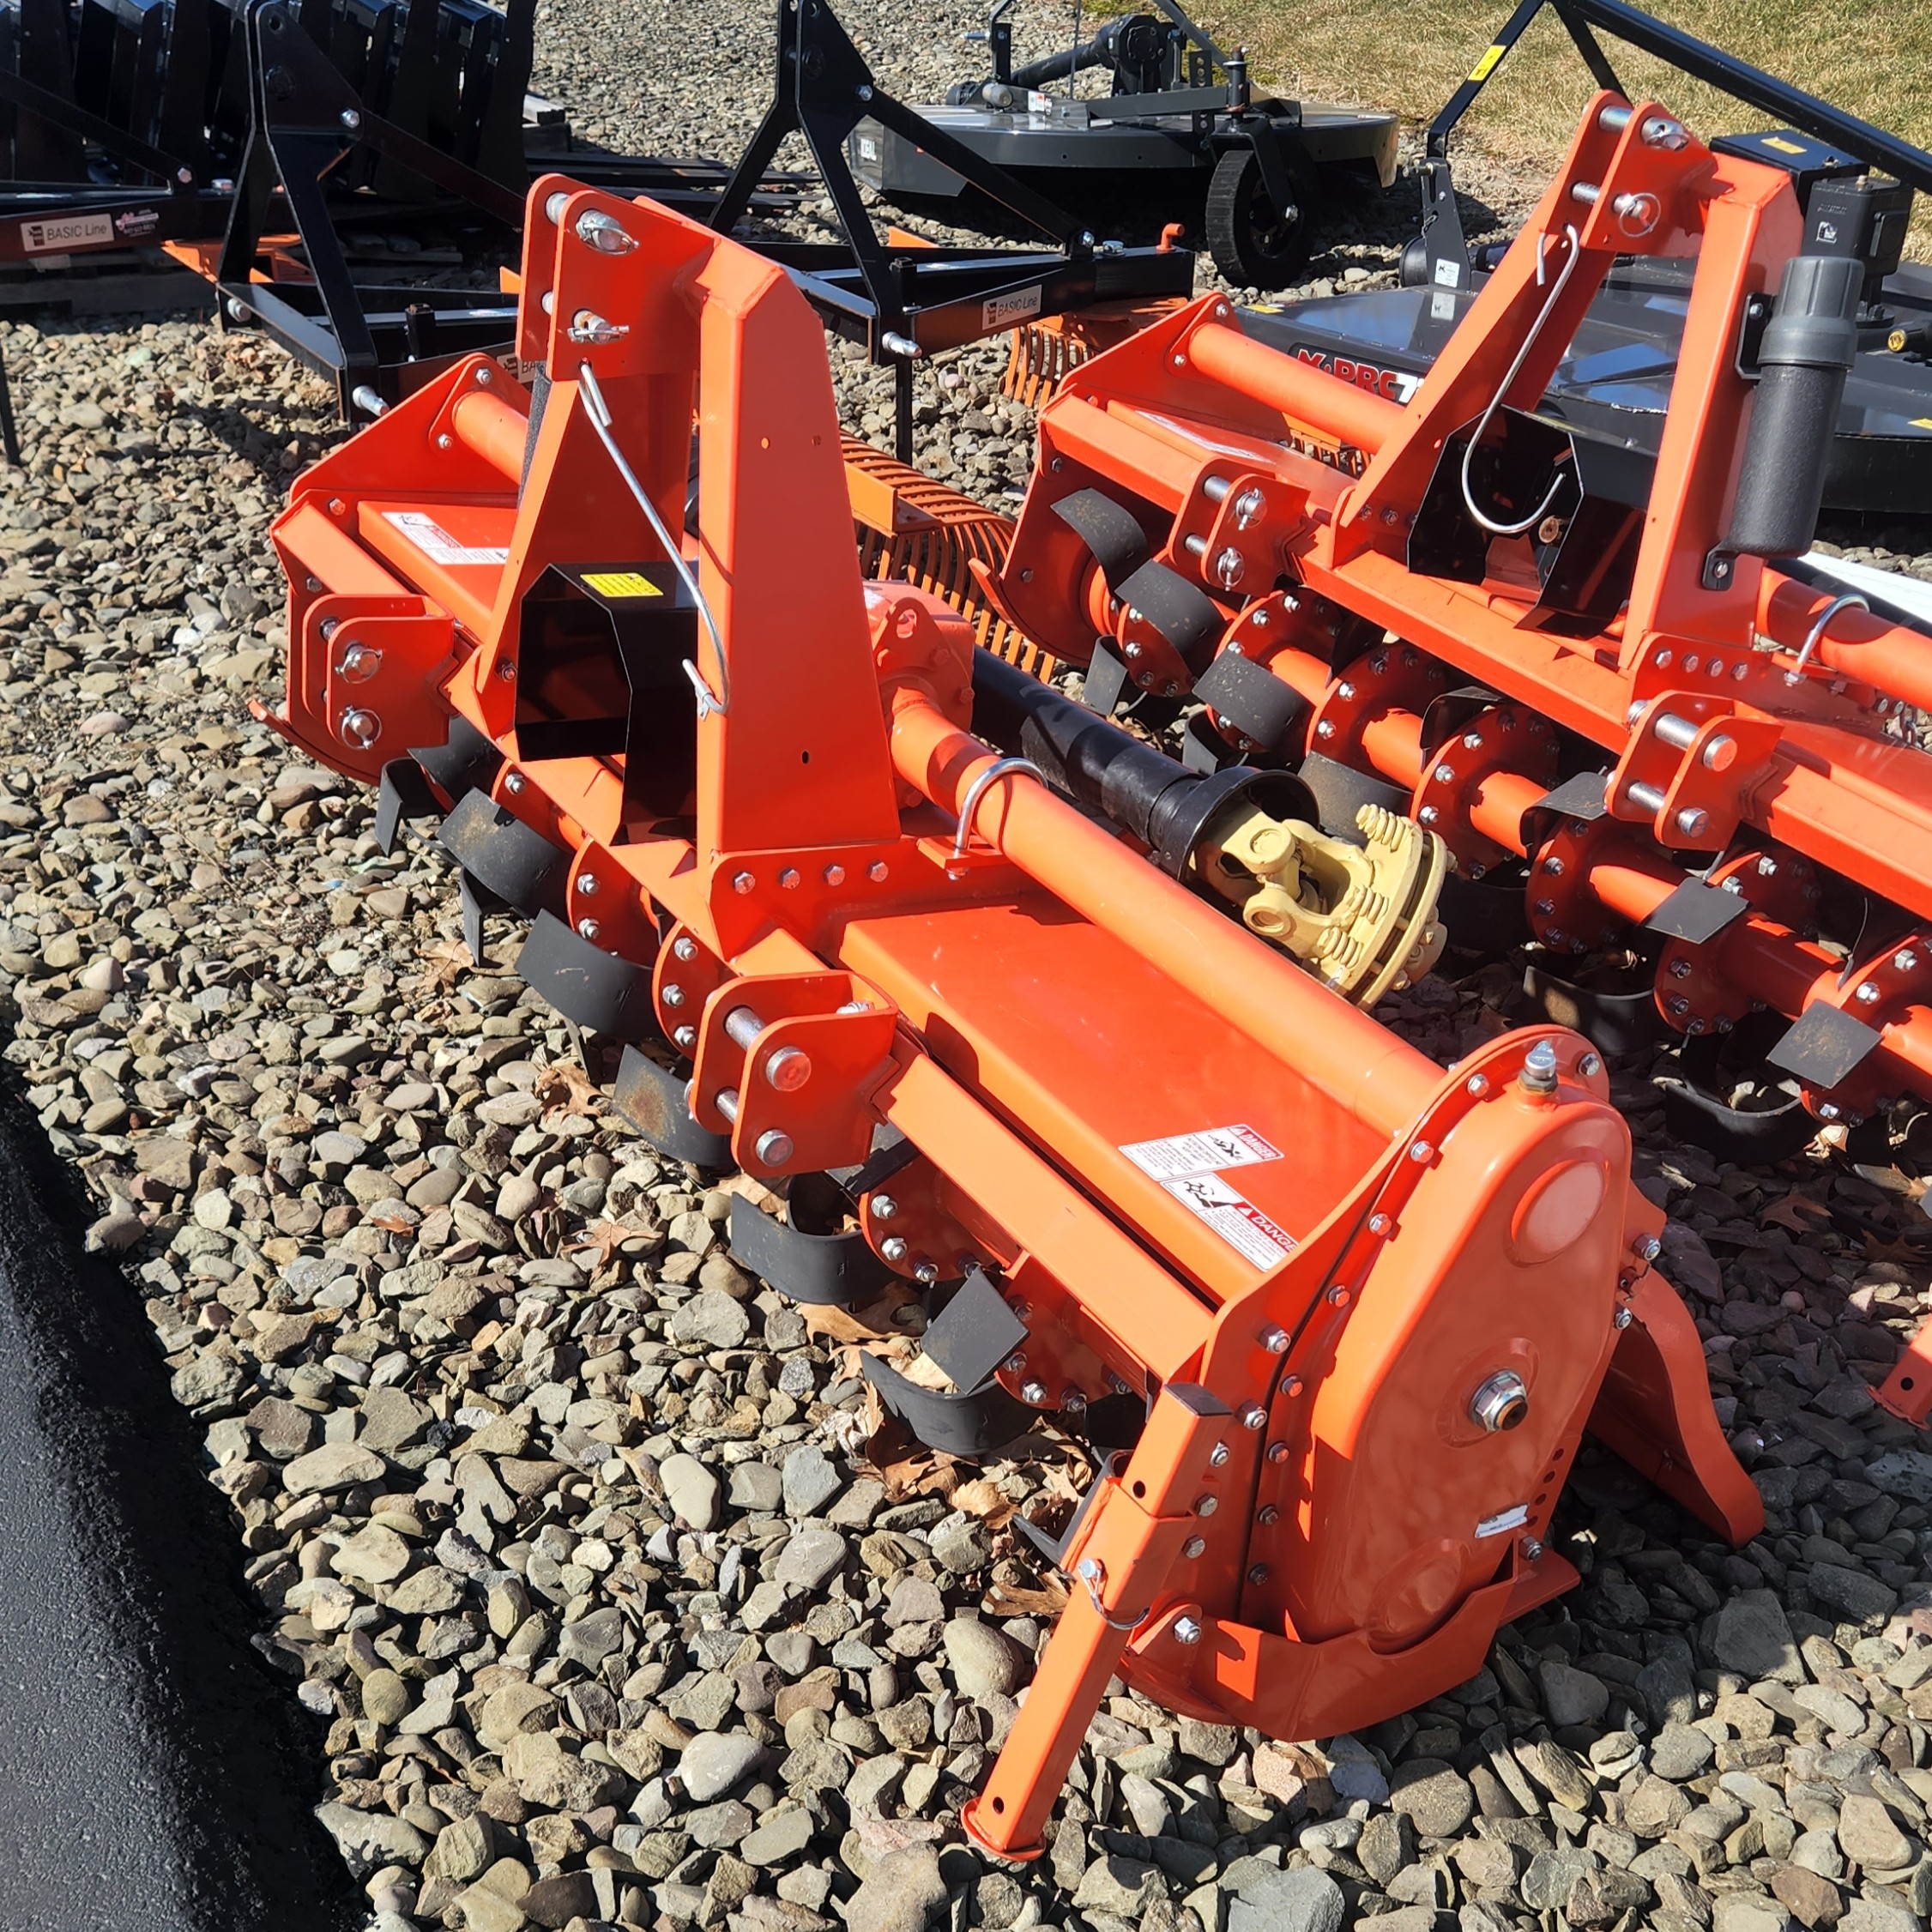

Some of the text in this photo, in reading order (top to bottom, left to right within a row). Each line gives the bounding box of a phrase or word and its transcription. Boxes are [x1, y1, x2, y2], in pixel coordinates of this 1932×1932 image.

[46, 226, 83, 241] BASIC
[85, 223, 107, 237] Line
[997, 296, 1037, 317] BASIC Line
[1238, 1132, 1277, 1159] DANGER
[1251, 1215, 1296, 1253] DANGE
